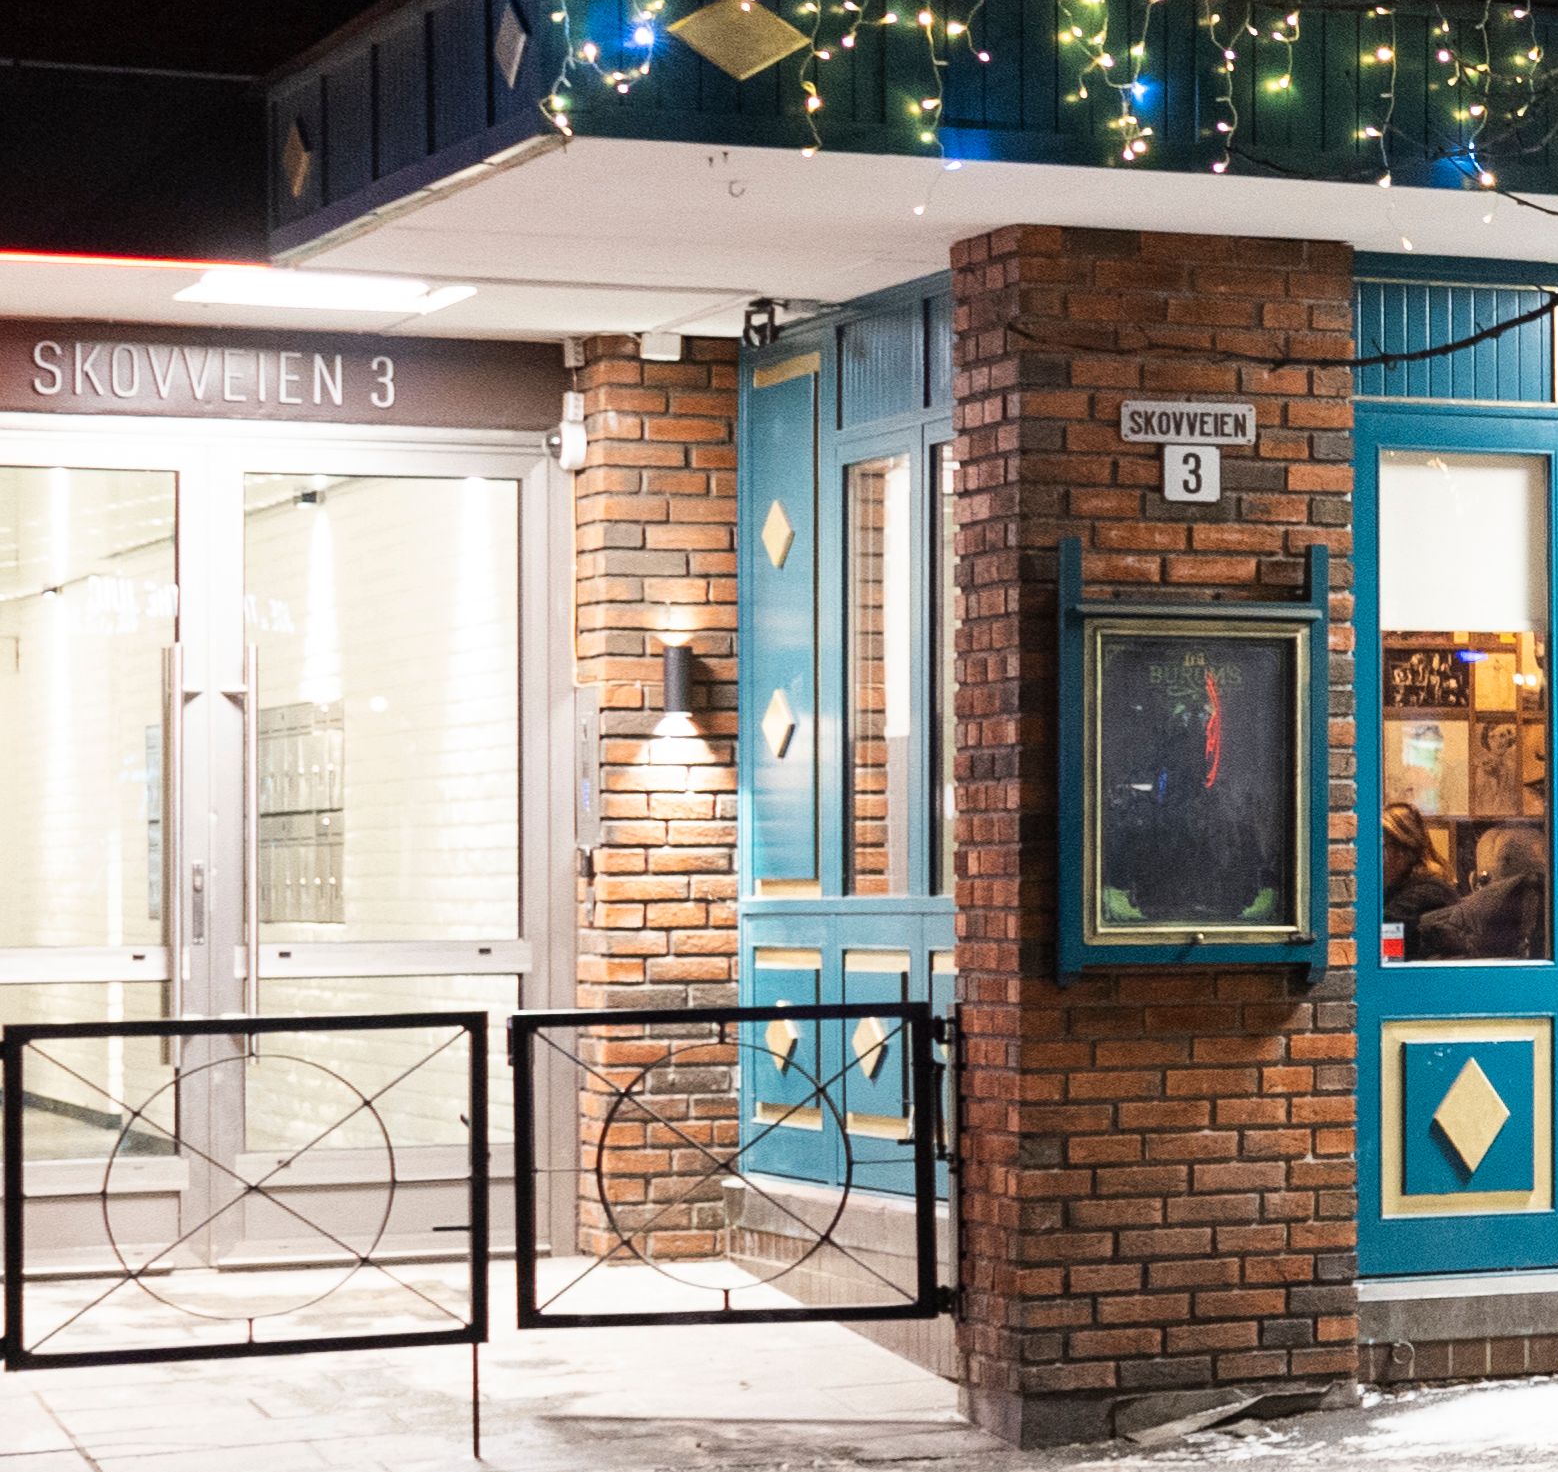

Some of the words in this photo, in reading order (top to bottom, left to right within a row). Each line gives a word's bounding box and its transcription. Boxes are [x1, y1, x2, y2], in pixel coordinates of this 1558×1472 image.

[32, 340, 343, 406] SKOVVEIEN
[369, 356, 396, 408] 3
[1129, 410, 1247, 438] SKOVVEIEN
[1182, 452, 1202, 494] 3
